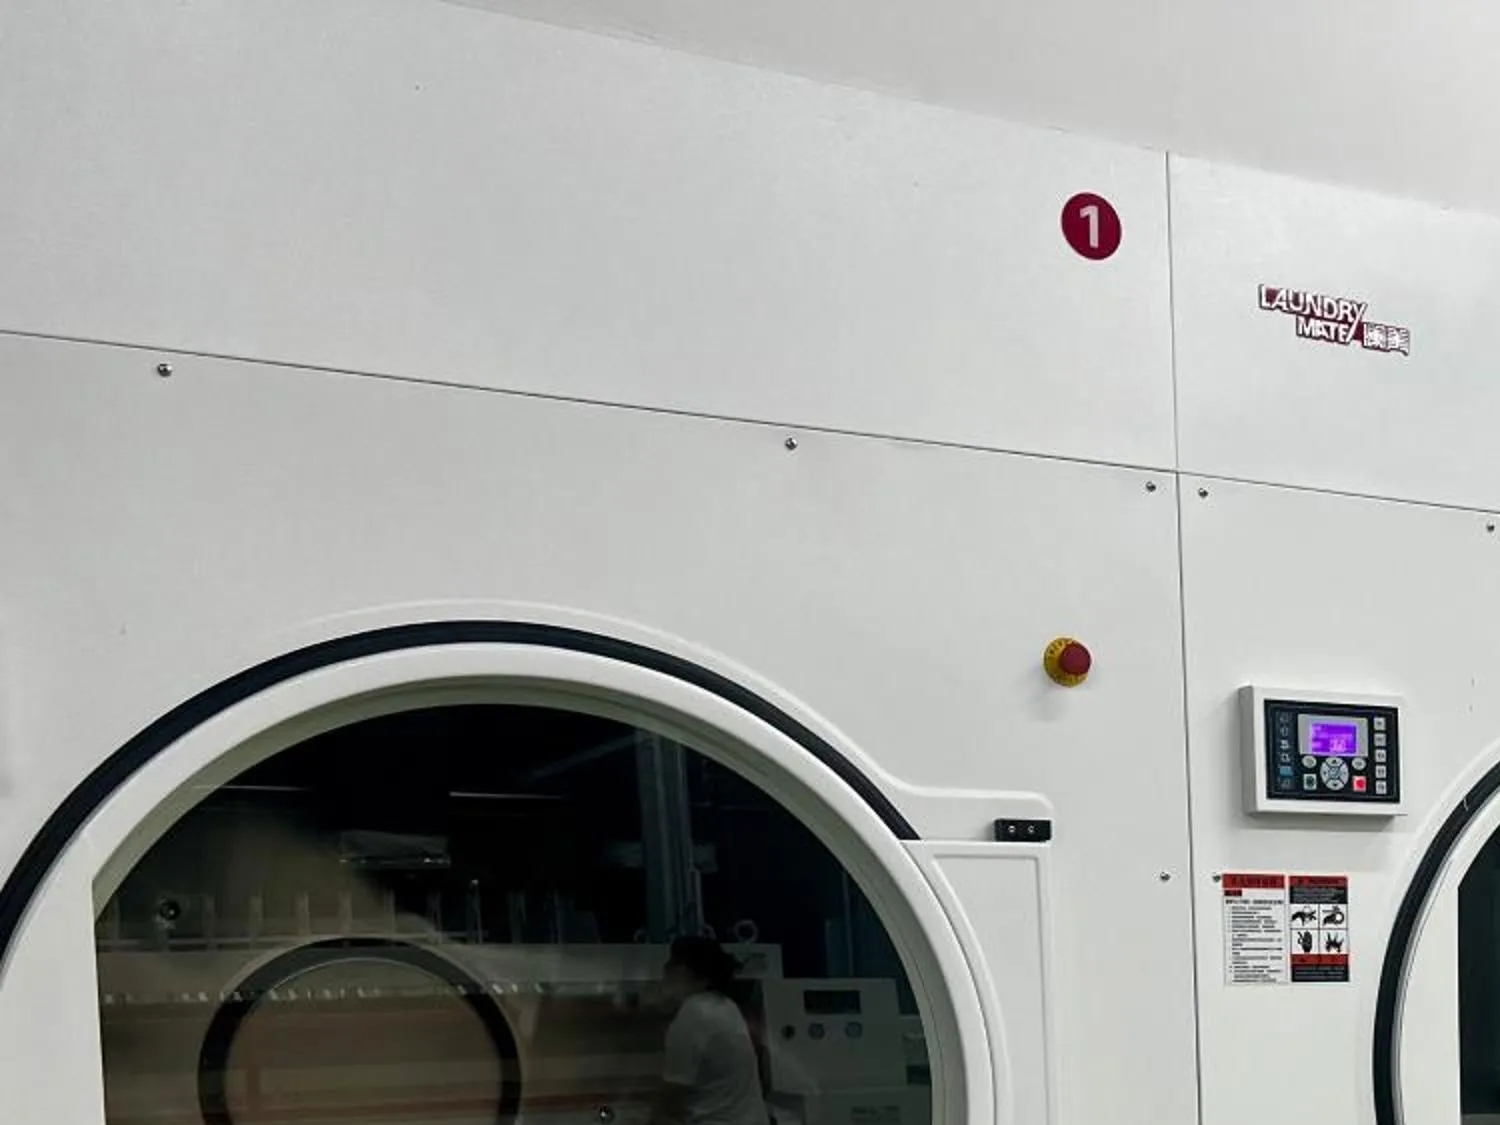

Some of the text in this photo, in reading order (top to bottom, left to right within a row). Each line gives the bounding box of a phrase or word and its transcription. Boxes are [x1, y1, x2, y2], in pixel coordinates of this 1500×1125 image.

[1080, 205, 1099, 248] 1
[1258, 284, 1368, 323] LAUNDRY
[1297, 316, 1350, 344] MATE
